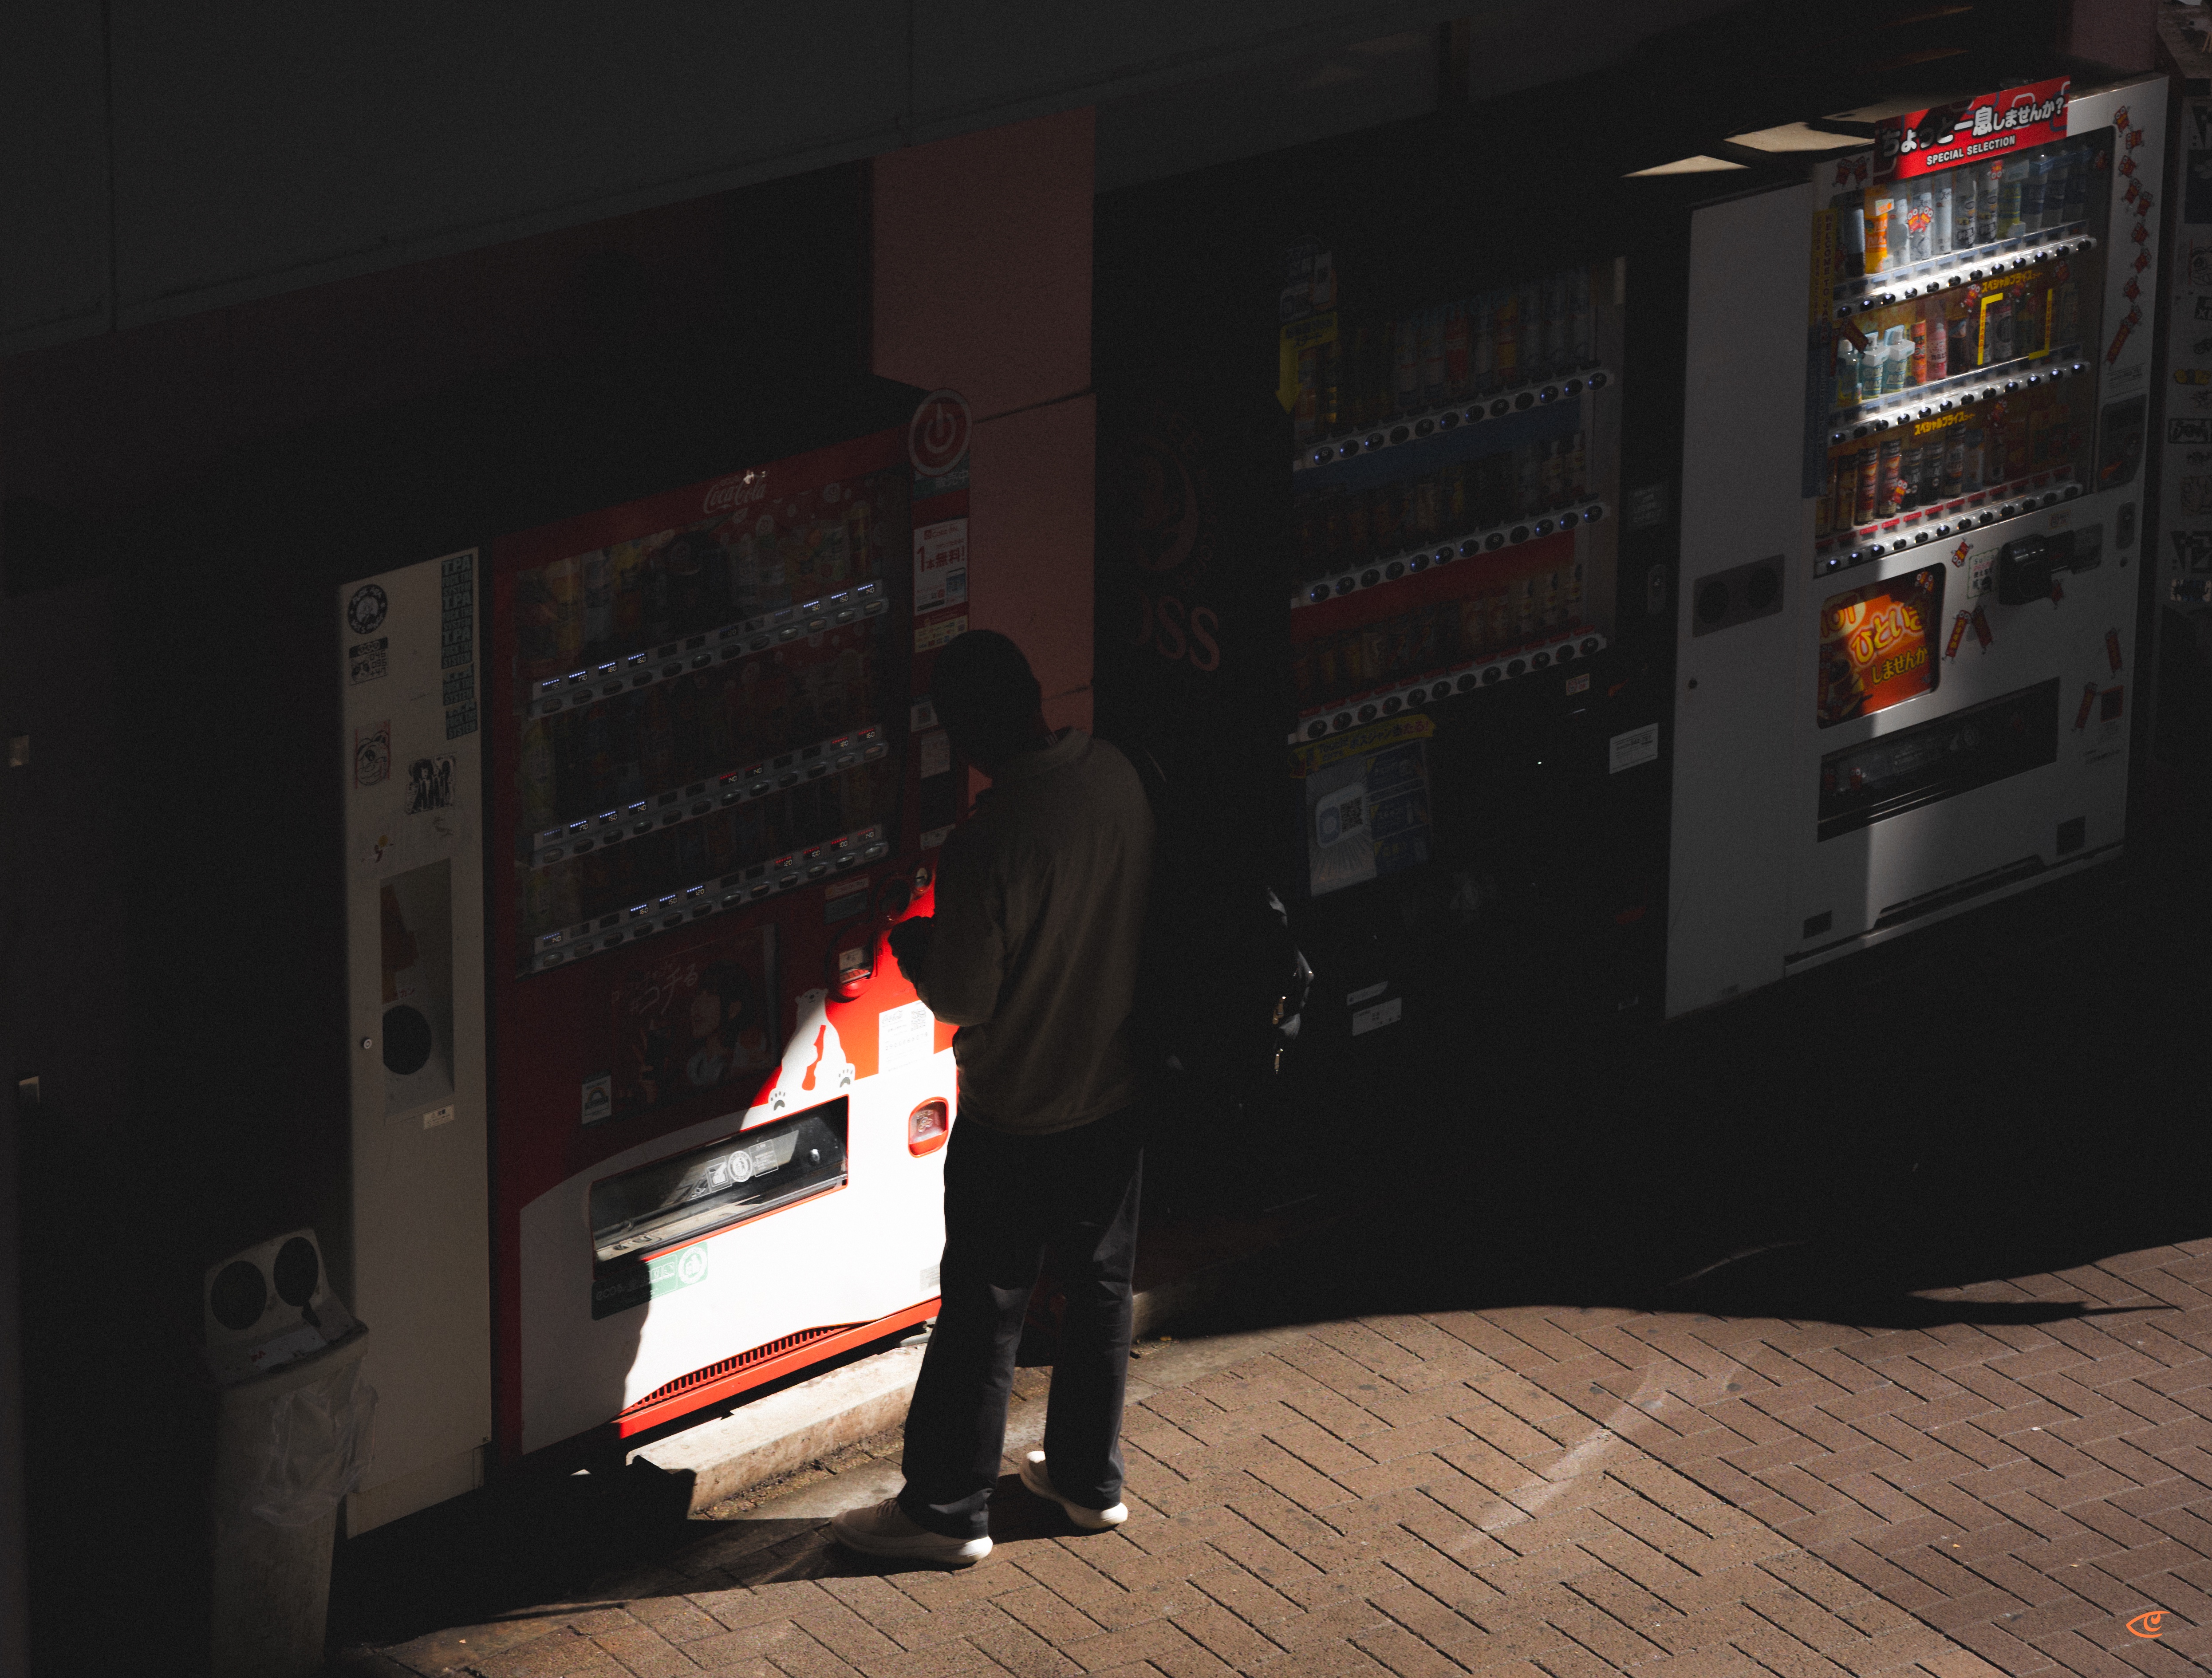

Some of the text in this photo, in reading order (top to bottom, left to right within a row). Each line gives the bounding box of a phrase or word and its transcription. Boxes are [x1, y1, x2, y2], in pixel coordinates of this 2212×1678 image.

[1926, 135, 2016, 165] SPECIAL SELECTION
[917, 545, 966, 572] 1本無料!
[443, 582, 472, 596] SYSTEM
[443, 617, 472, 631] SYSTEM
[443, 652, 471, 668] SYSTEM
[1871, 645, 1928, 684] しませんか
[444, 688, 473, 705] SYSTEM
[448, 723, 476, 740] SYSTEM
